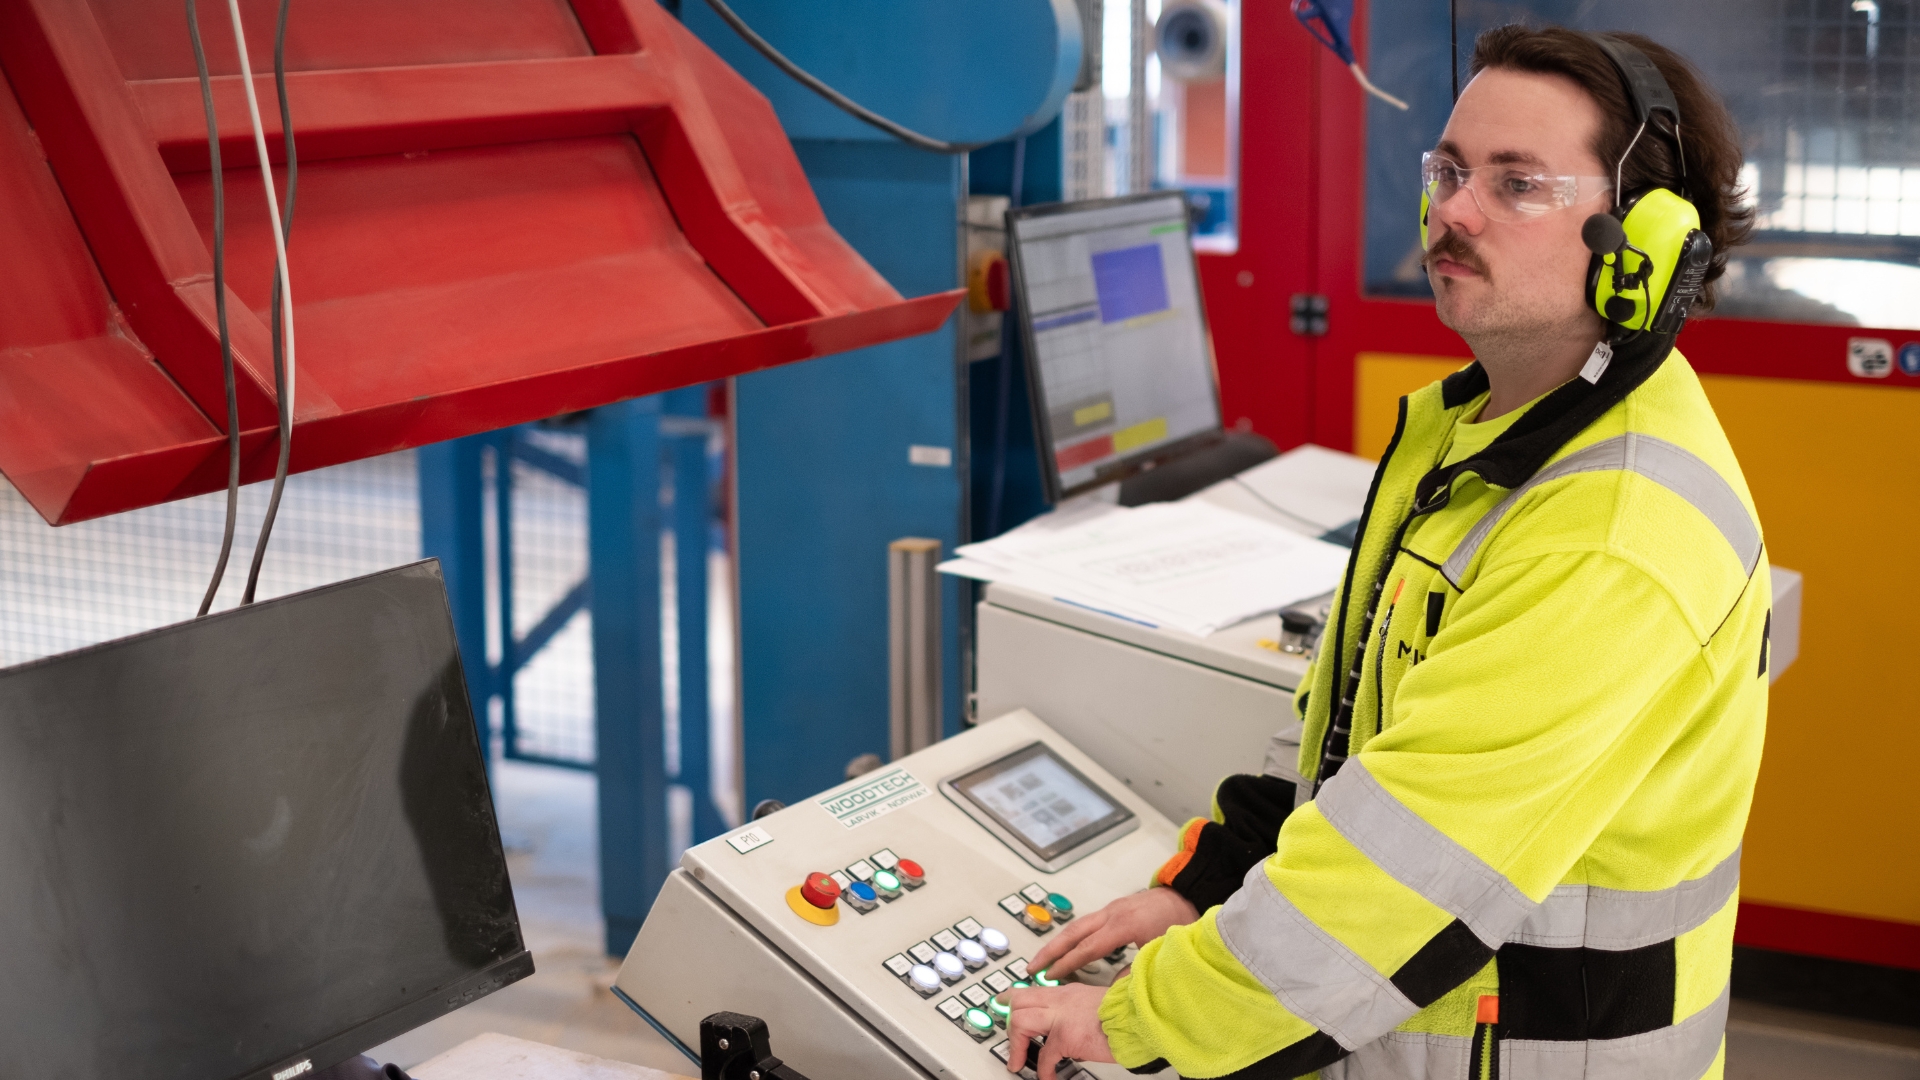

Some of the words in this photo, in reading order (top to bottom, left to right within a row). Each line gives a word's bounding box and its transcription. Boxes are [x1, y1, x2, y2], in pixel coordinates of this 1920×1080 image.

[824, 772, 916, 815] WOODTECH
[843, 809, 880, 828] LARVIK
[887, 787, 929, 809] NORWAY
[740, 832, 760, 846] P10
